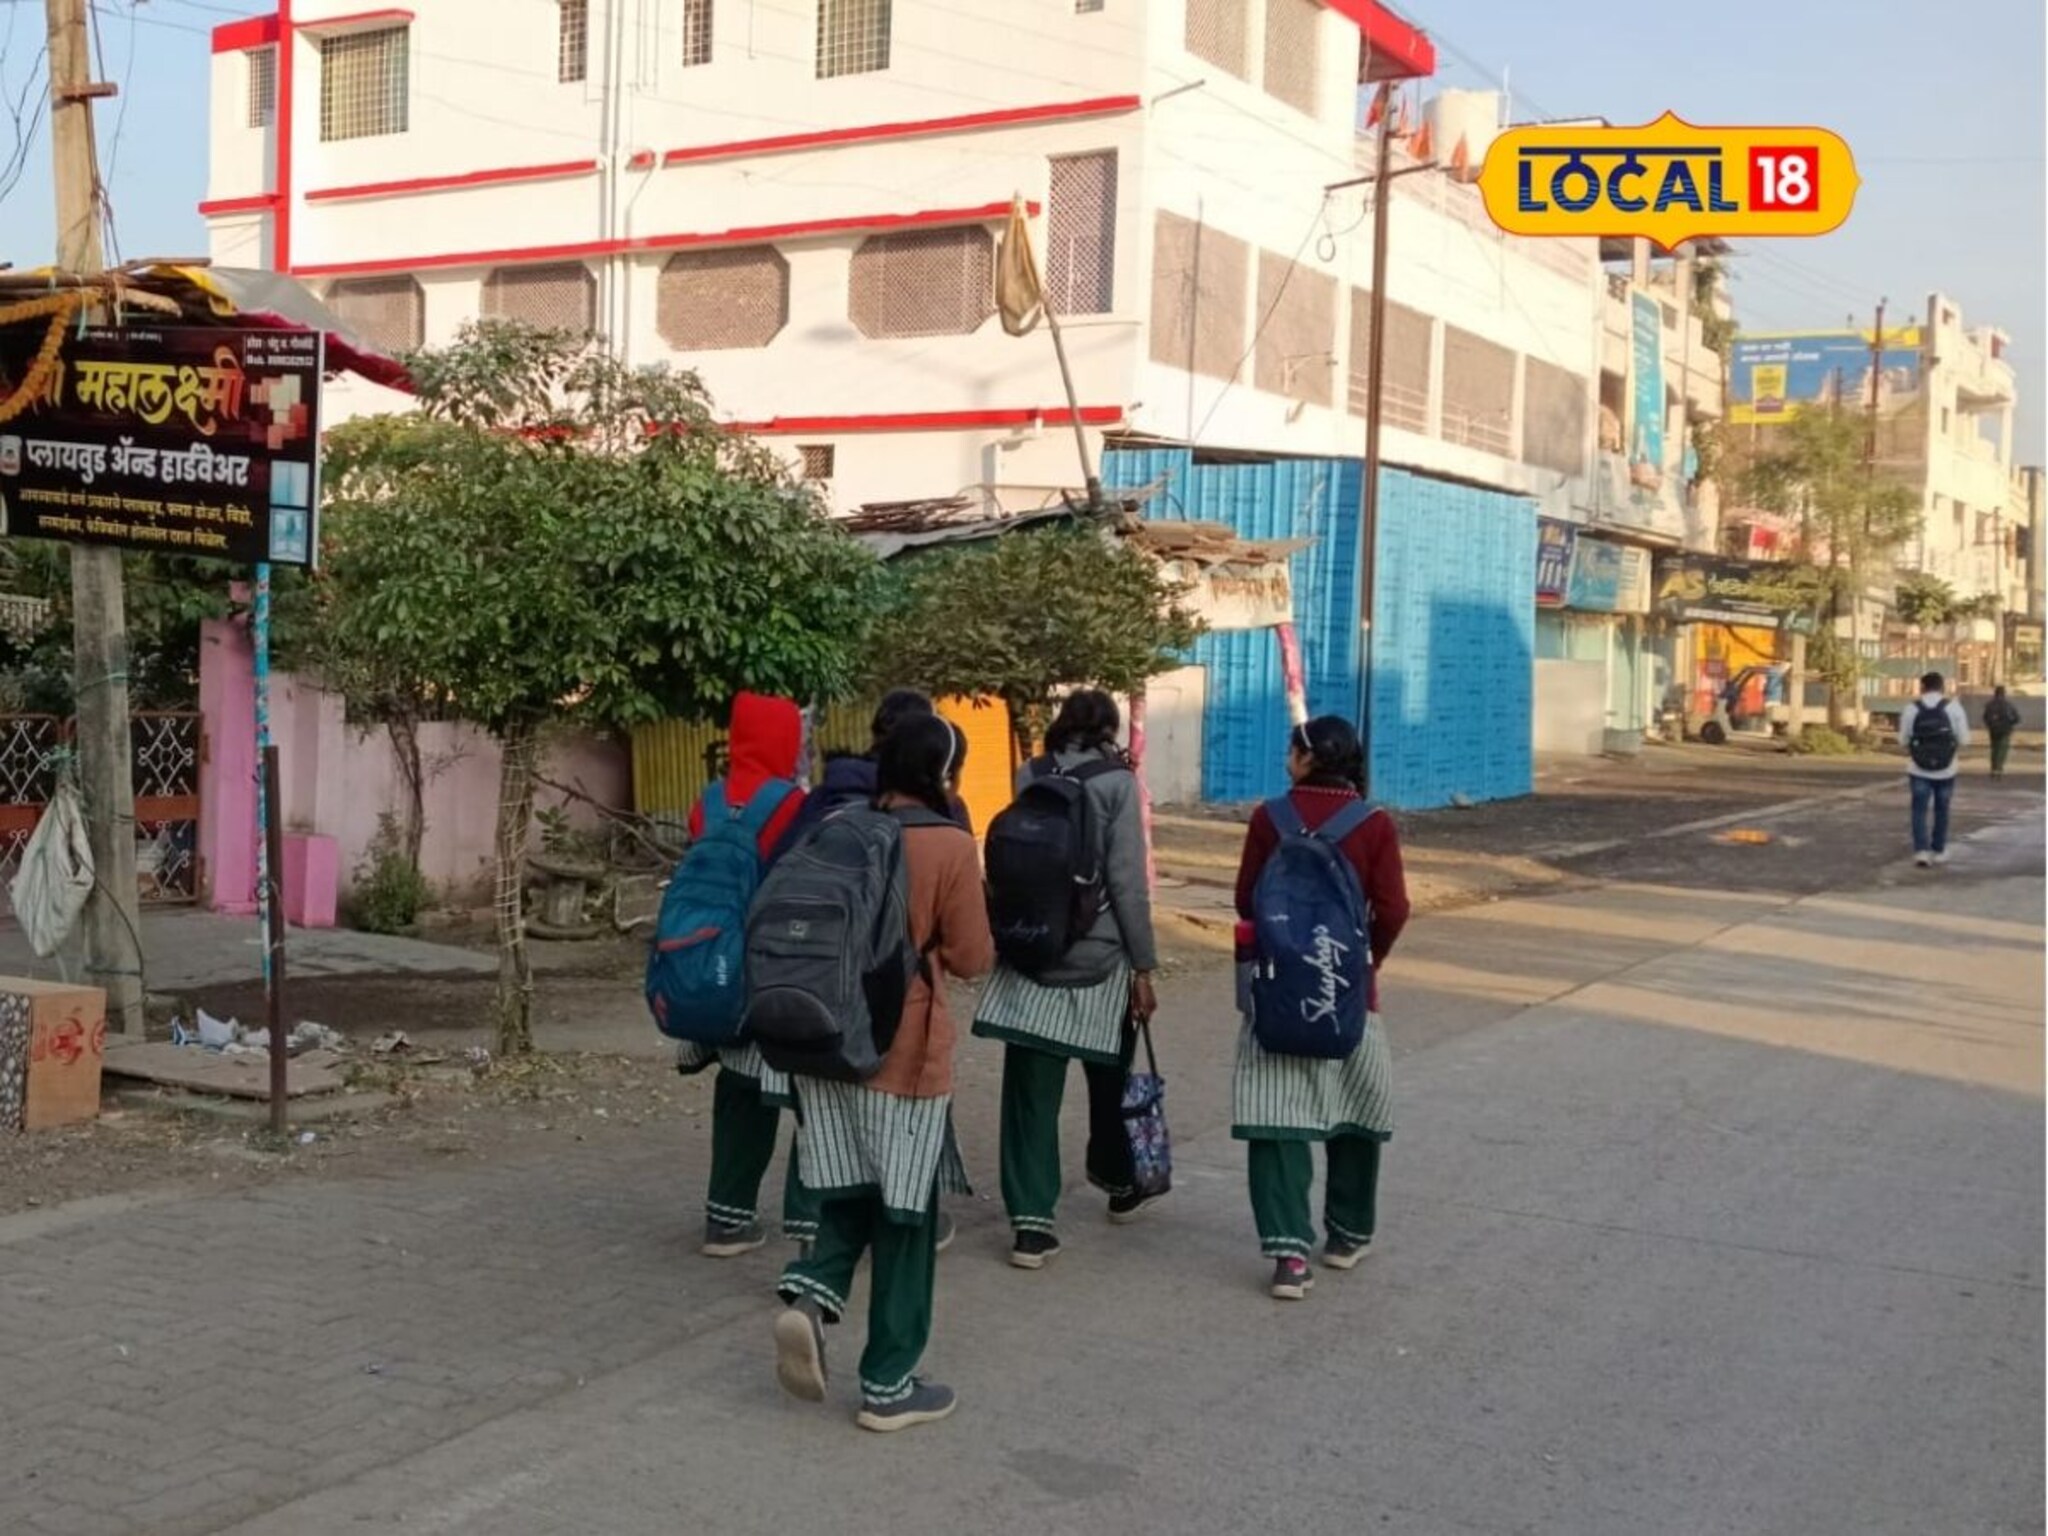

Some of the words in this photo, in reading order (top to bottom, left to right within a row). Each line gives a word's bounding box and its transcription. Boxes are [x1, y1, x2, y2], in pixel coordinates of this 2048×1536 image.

[75, 346, 245, 436] महालक्ष्मी
[26, 438, 107, 484] प्लायवुड
[160, 443, 250, 487] हार्डवेअर
